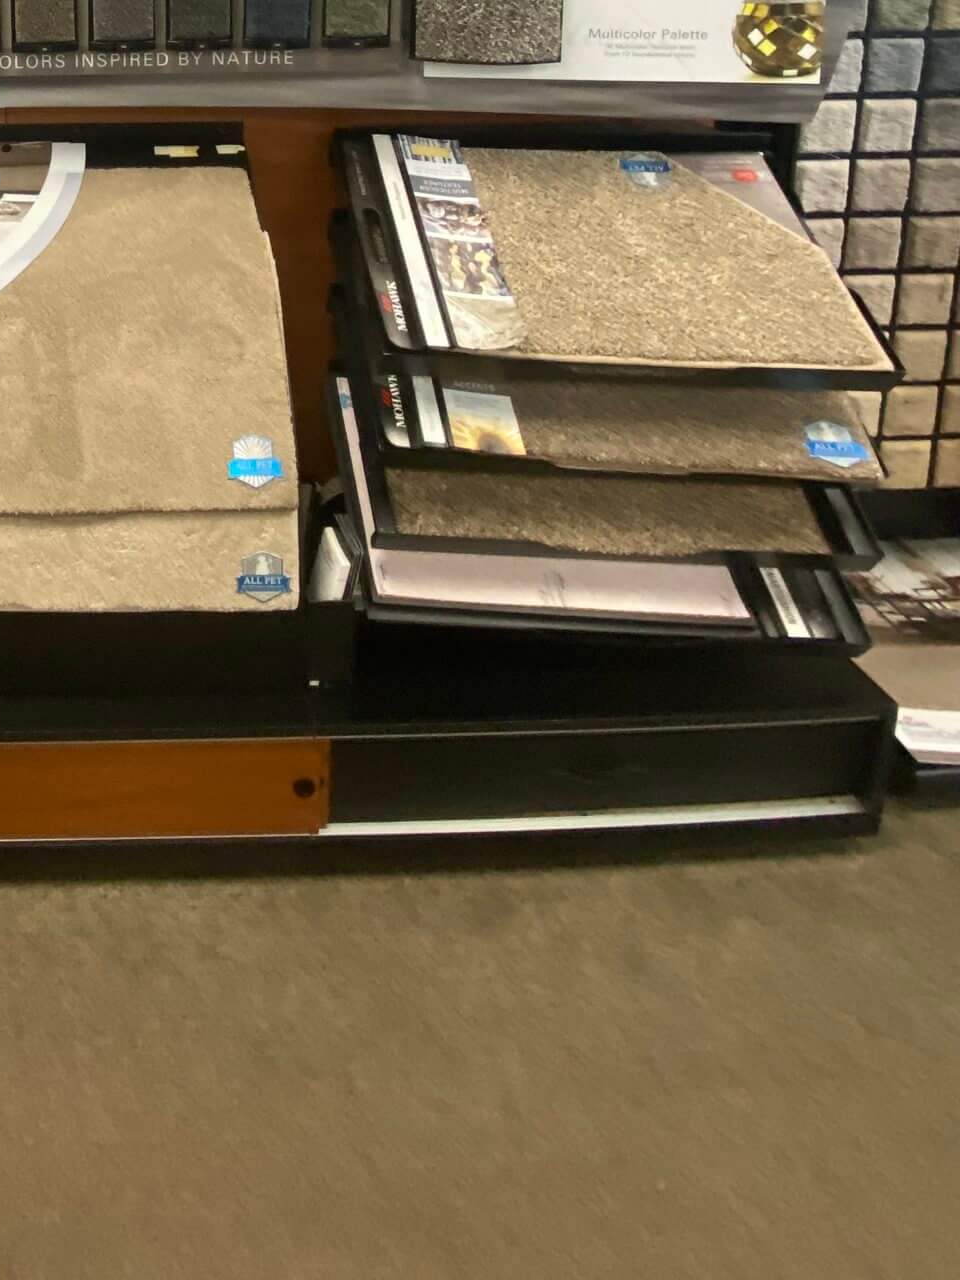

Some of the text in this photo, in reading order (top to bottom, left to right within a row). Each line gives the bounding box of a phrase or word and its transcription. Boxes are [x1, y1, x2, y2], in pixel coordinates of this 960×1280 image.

[588, 28, 709, 40] Multicolor Palette
[74, 51, 170, 68] INSPIRED
[177, 51, 204, 67] BY
[211, 49, 295, 66] NATURE
[386, 279, 409, 332] MOHAWK
[243, 575, 283, 585] ALL PET
